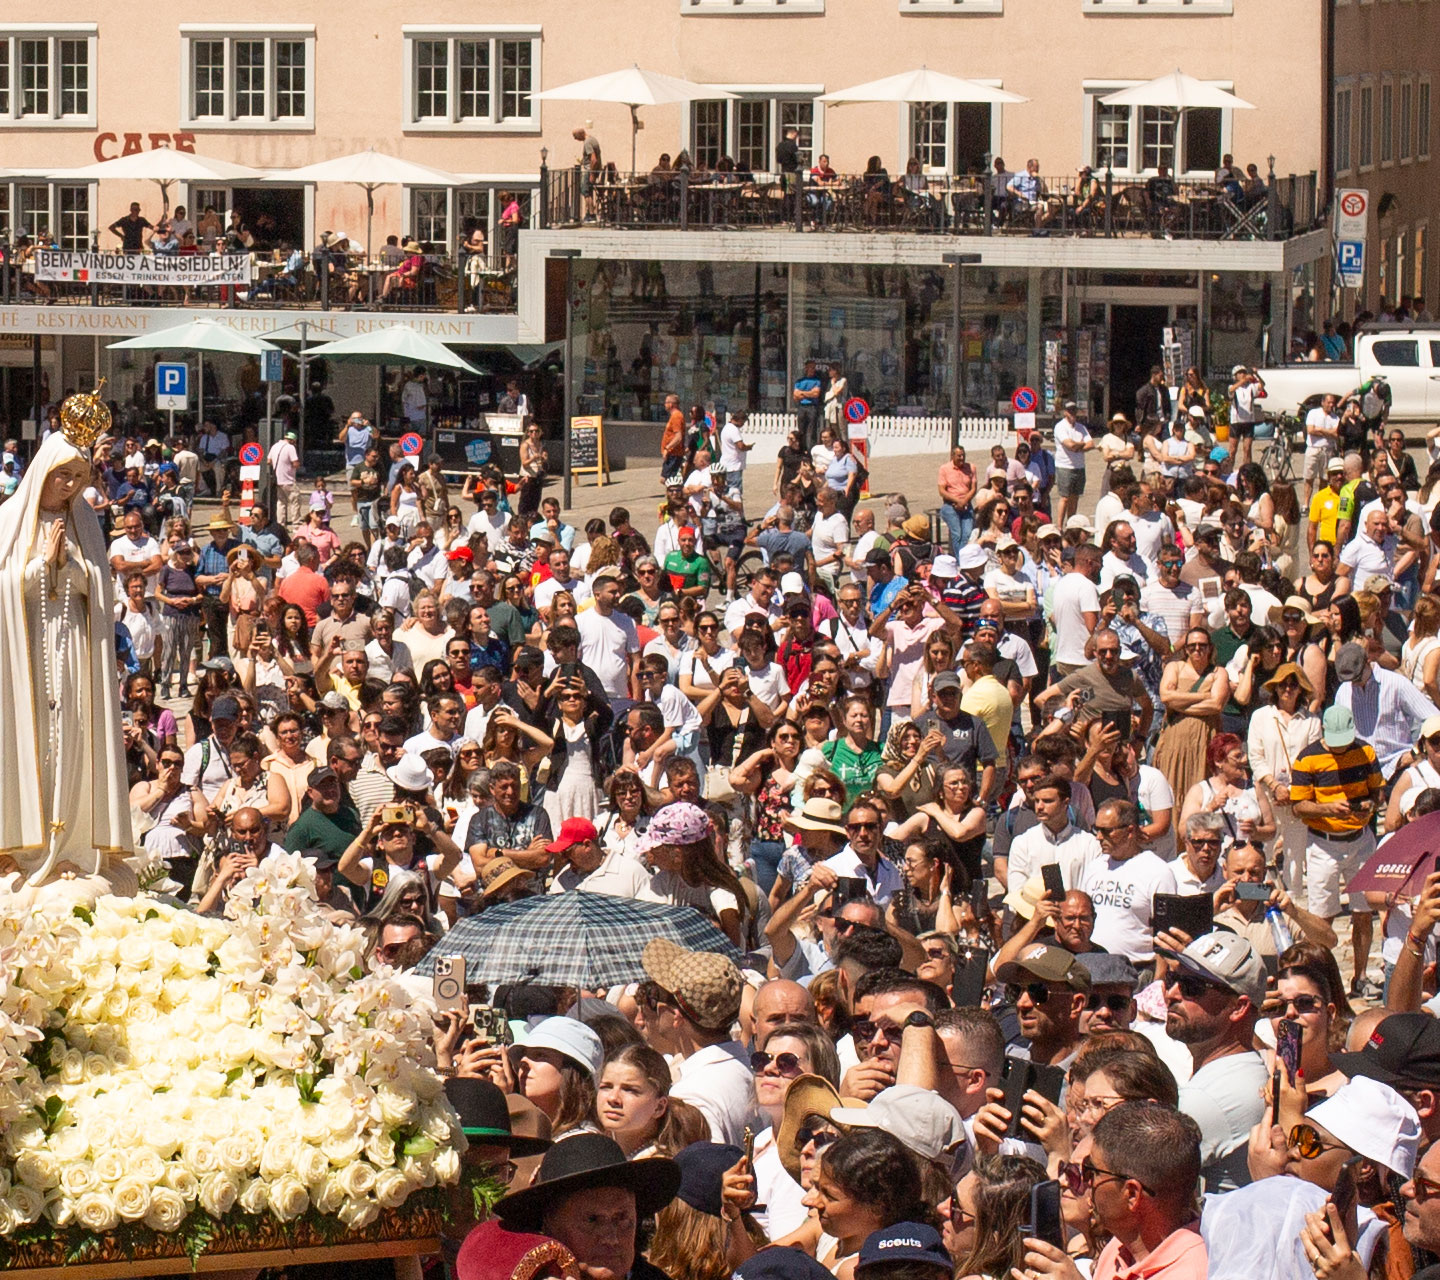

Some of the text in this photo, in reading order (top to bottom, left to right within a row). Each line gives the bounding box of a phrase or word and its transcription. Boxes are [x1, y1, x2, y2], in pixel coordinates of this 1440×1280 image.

[41, 252, 136, 271] BEM-VINDOS
[154, 256, 244, 272] EINSIEDELN!
[1342, 245, 1355, 264] P
[95, 271, 124, 281] ESSEN
[131, 272, 170, 282] TRINKEN
[36, 312, 151, 329] RESTAURANT
[193, 316, 278, 332] CKEREI
[356, 318, 475, 336] RESTURANT
[165, 369, 179, 392] P
[1376, 863, 1412, 873] SORELL
[1092, 892, 1132, 908] JONES
[879, 1238, 922, 1249] Scouts
